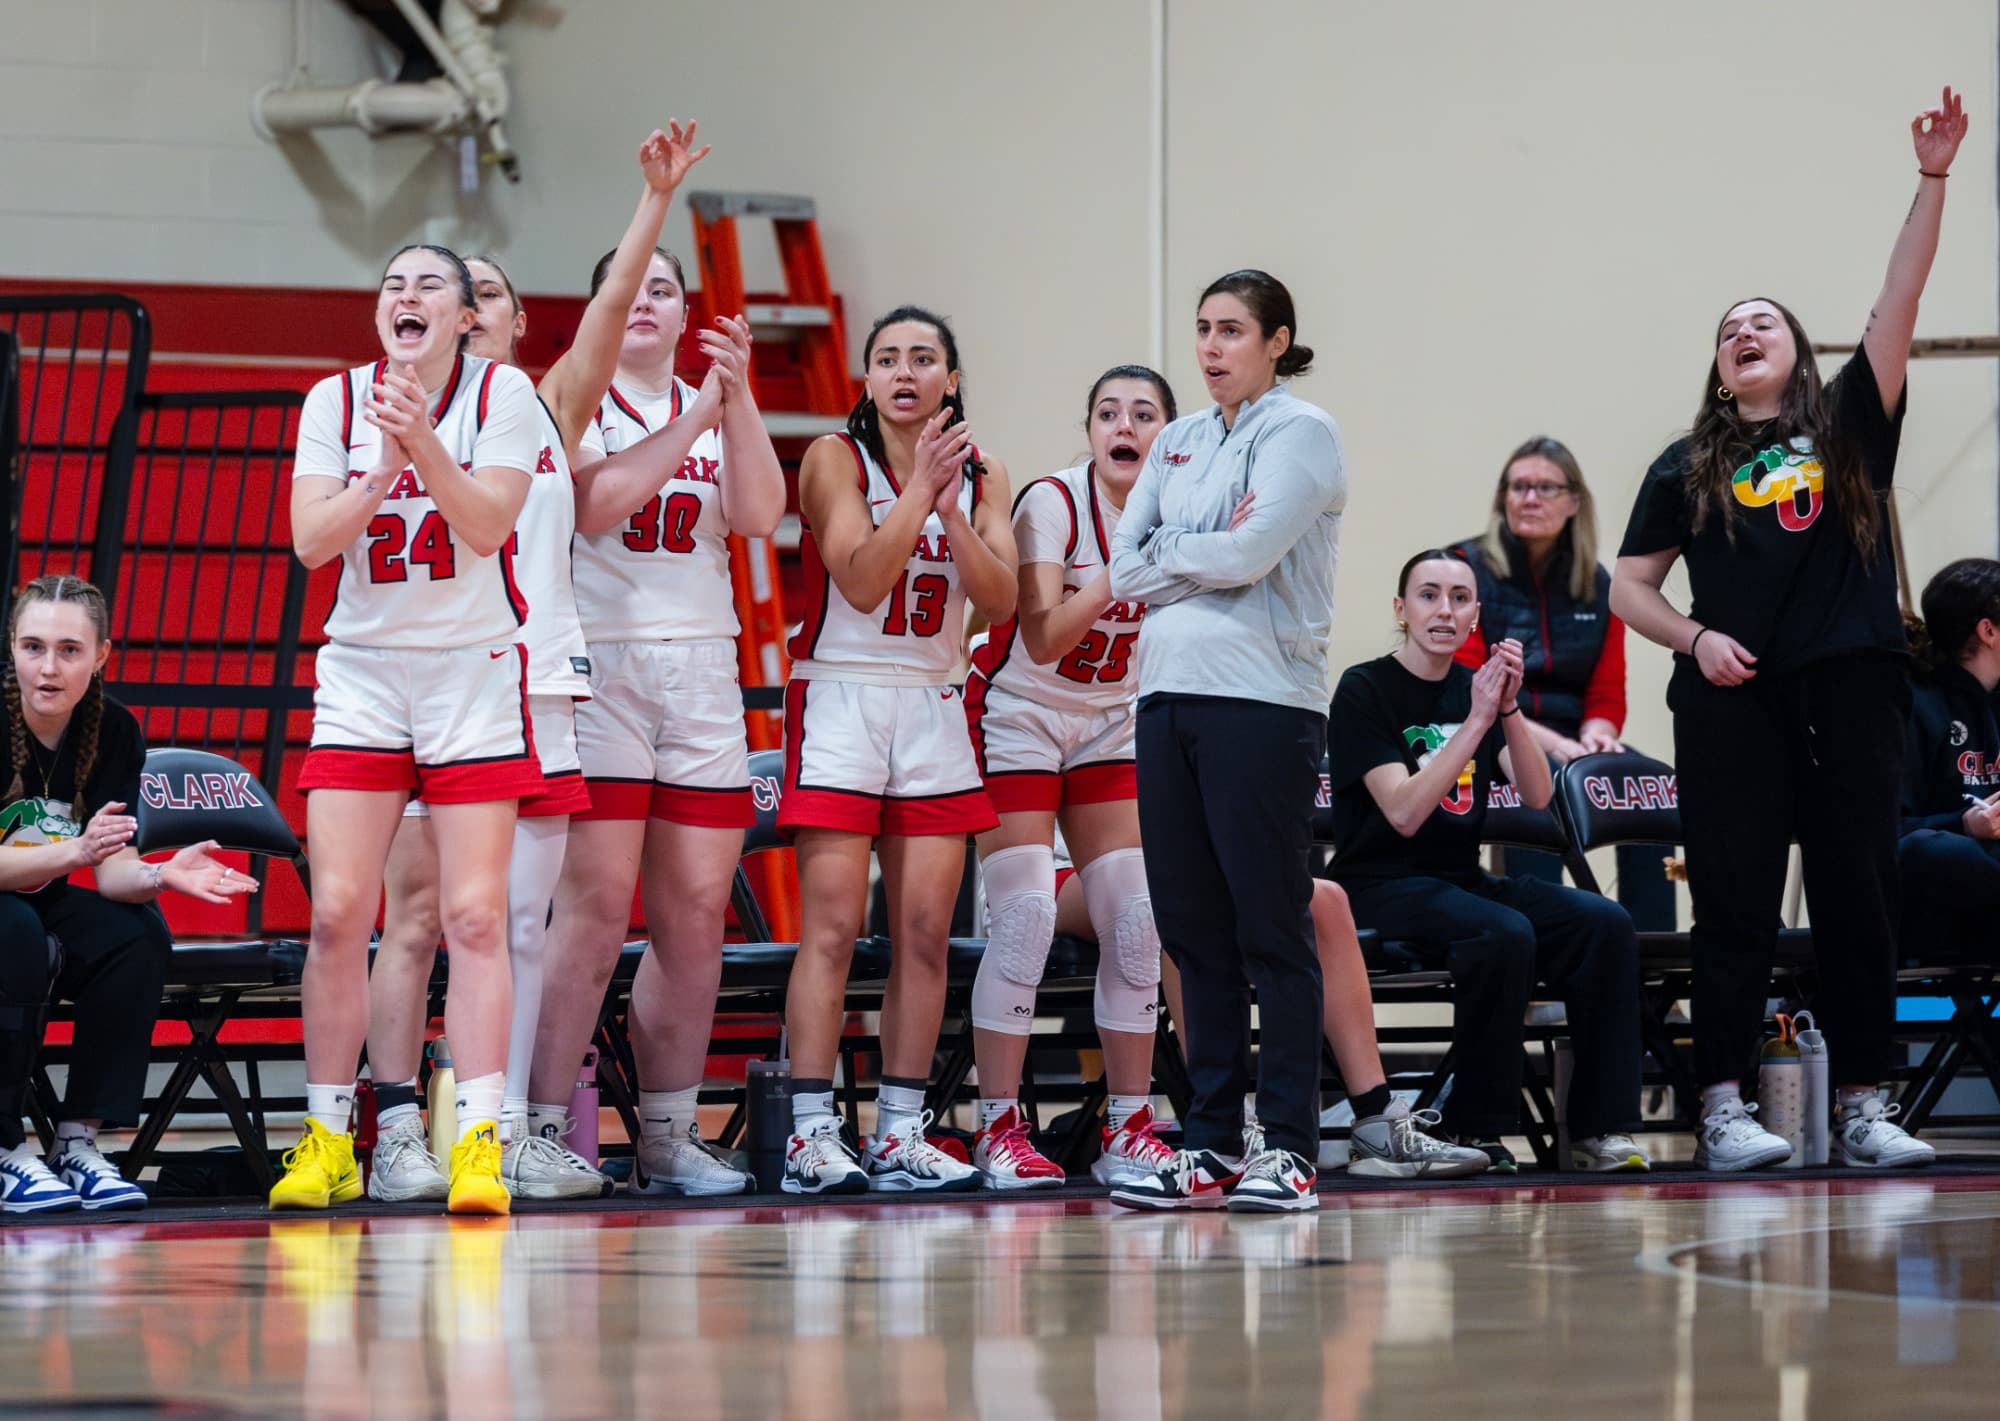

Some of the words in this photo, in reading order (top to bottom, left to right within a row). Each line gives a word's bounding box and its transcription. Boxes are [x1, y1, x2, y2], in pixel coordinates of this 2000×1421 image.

[367, 510, 456, 584] 24
[622, 491, 703, 554] 30
[881, 569, 950, 638] 13
[1055, 628, 1140, 684] 25
[140, 772, 264, 810] CLARK
[1584, 774, 1678, 810] CLARK
